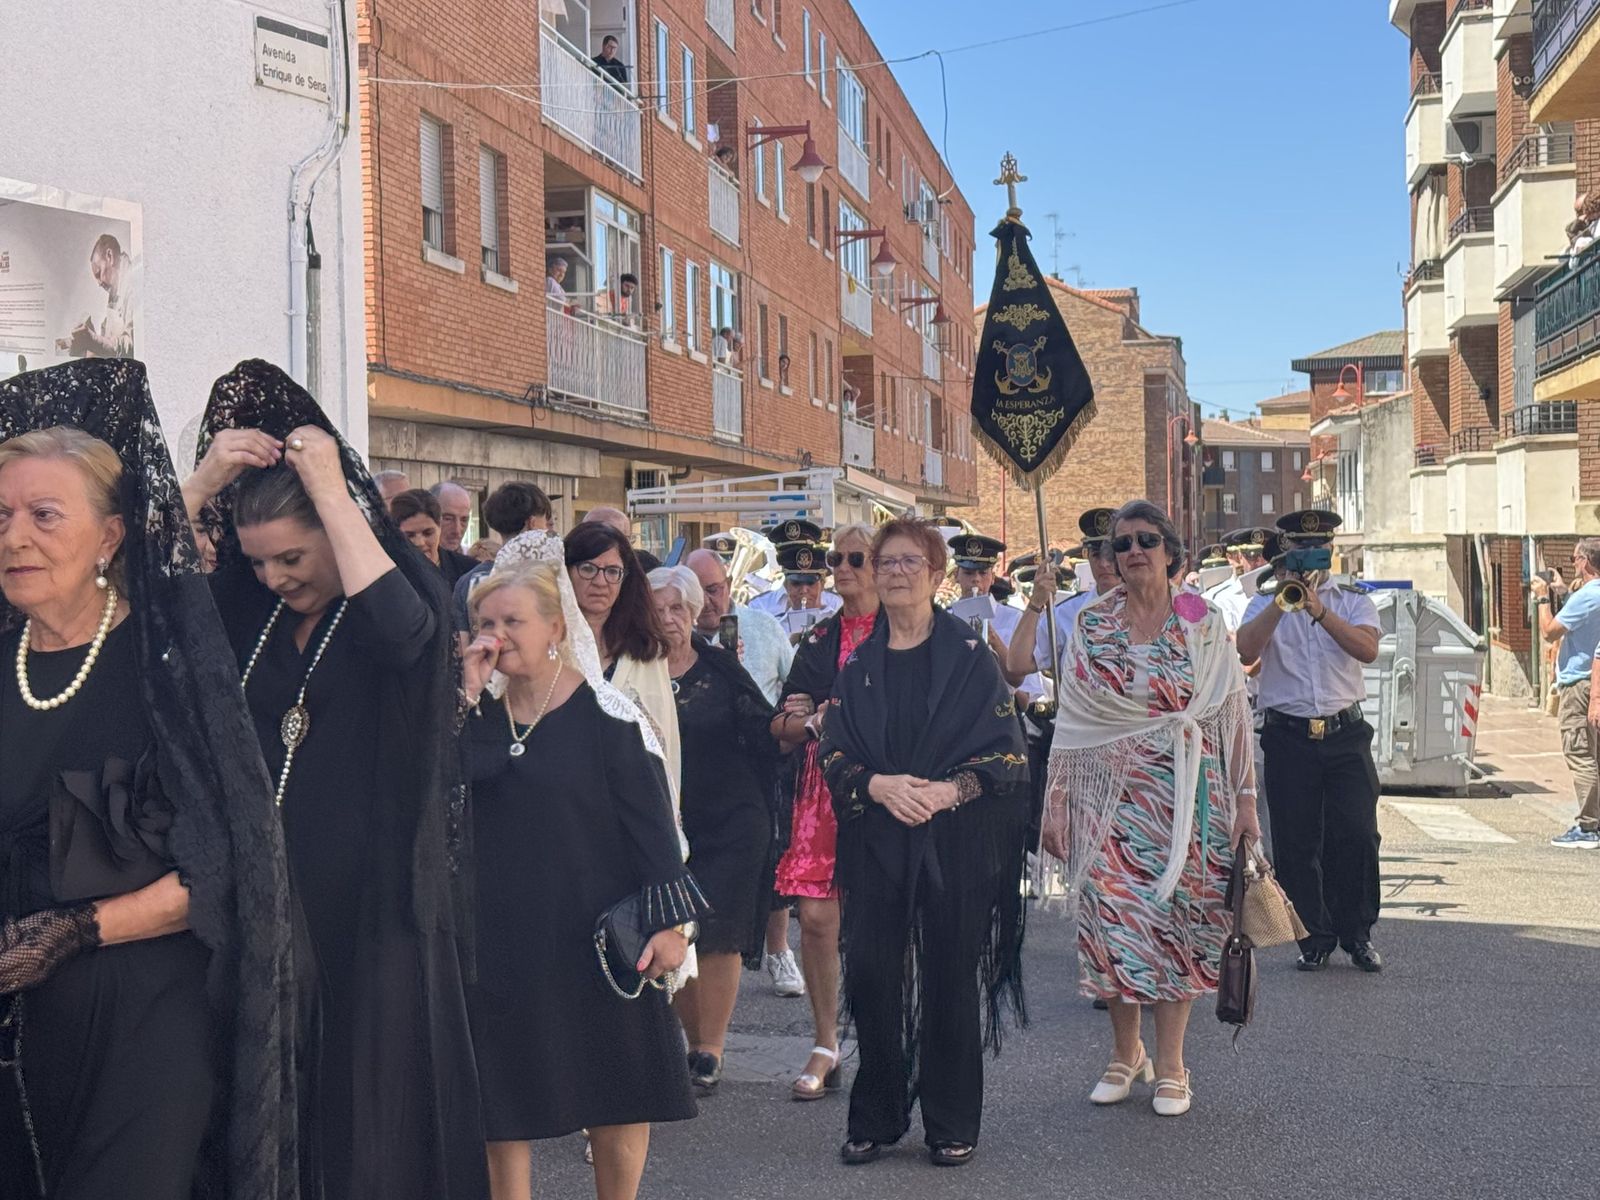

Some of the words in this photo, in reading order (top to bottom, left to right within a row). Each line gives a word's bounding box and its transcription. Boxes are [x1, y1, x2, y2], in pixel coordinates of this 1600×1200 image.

[262, 42, 296, 64] Avenida
[262, 63, 292, 84] Enrique
[294, 73, 305, 87] de
[307, 76, 327, 93] Sena
[1004, 395, 1056, 409] ESPERANZA
